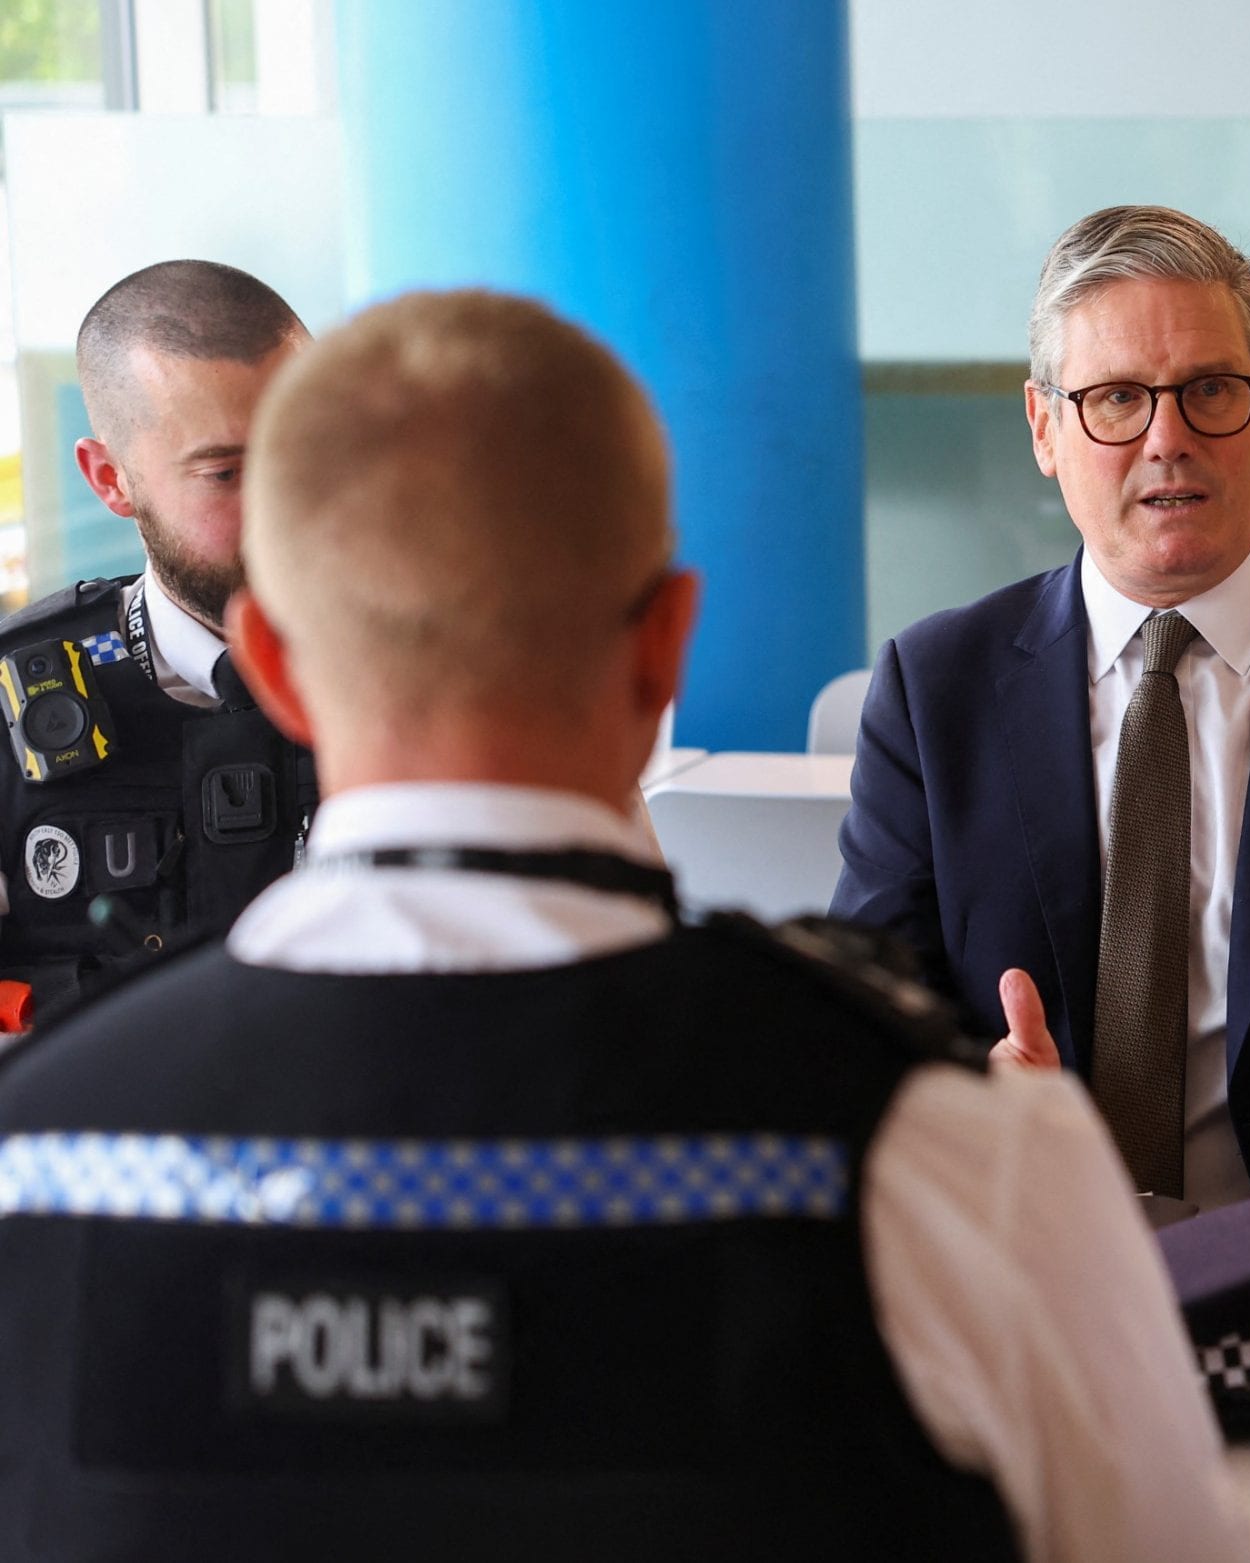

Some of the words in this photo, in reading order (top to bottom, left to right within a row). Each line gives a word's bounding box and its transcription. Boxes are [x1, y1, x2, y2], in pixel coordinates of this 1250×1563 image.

[56, 750, 79, 763] AXON
[105, 832, 137, 878] U
[251, 1294, 491, 1400] POLICE
